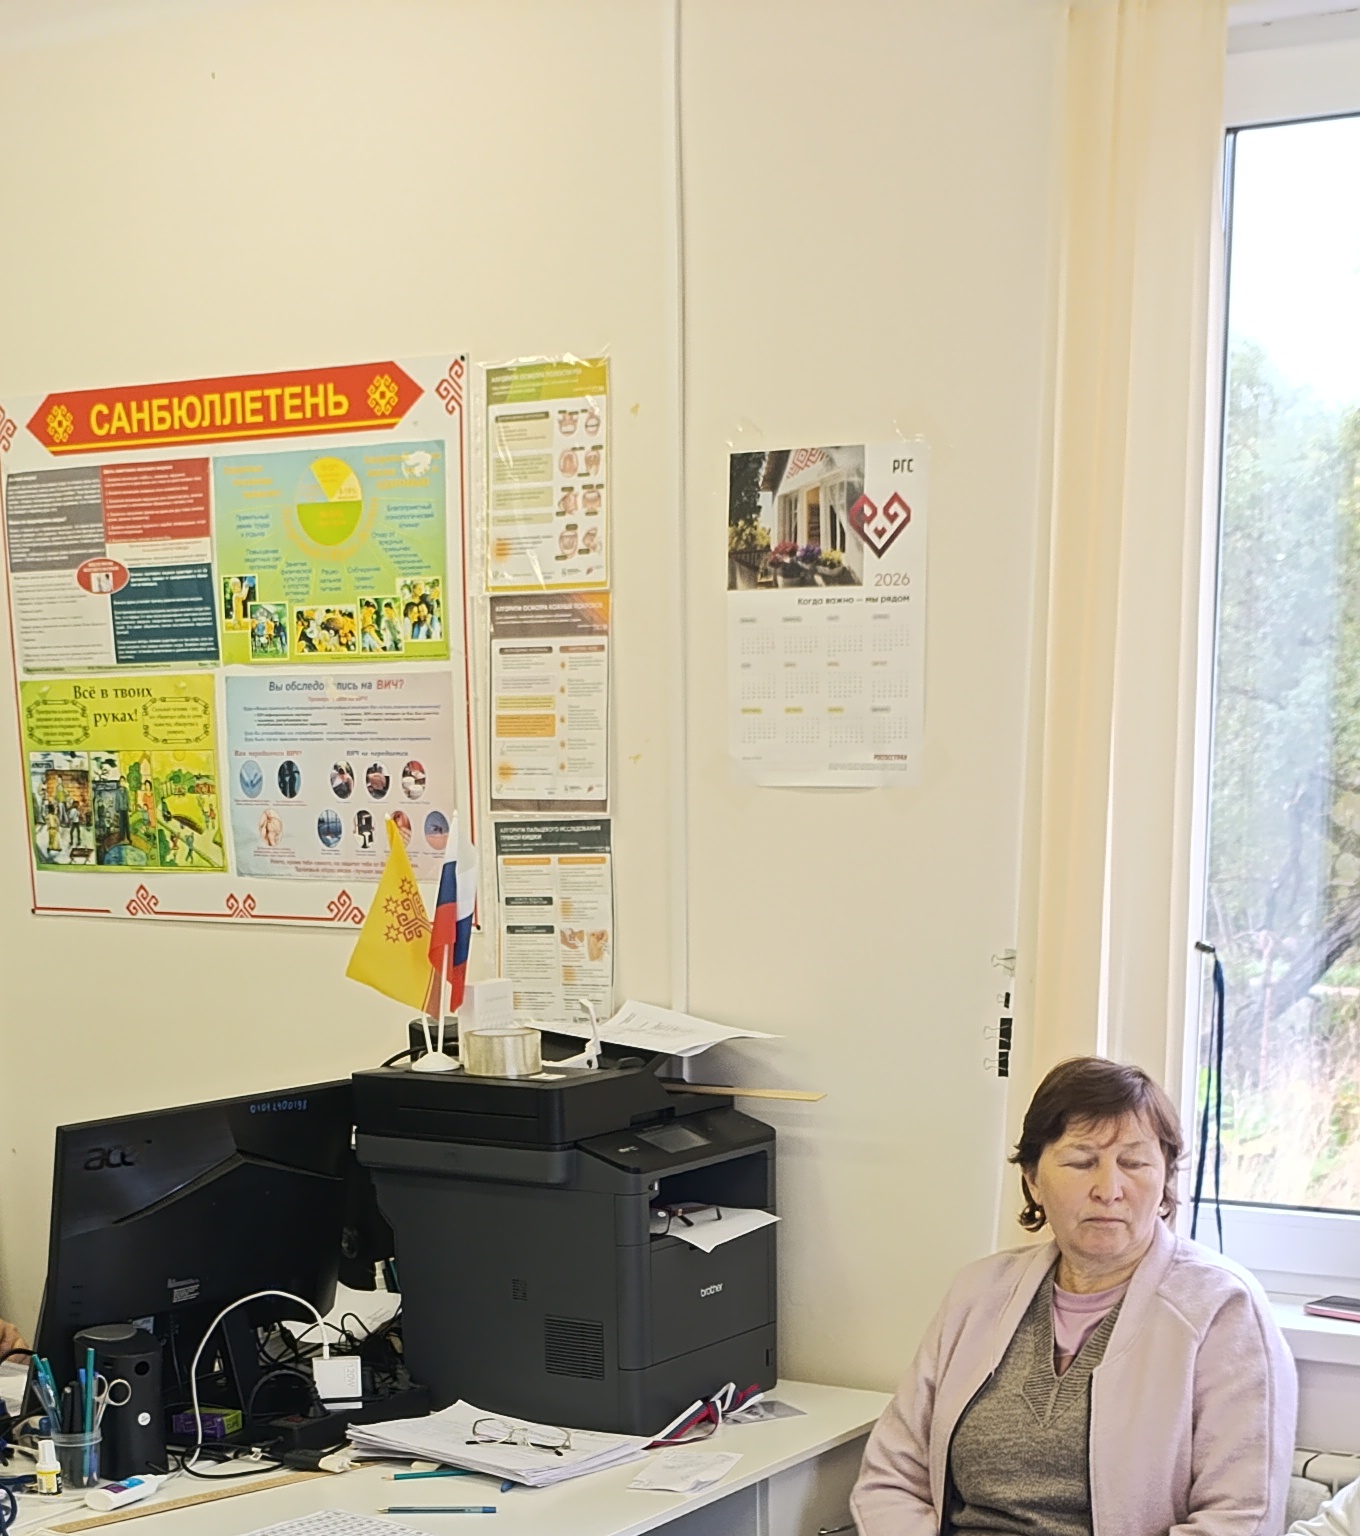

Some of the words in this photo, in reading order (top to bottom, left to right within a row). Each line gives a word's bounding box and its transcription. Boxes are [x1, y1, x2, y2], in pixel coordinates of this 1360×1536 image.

[89, 382, 350, 436] САНБЮЛЛЕТЕНЬ
[893, 460, 914, 473] РГС
[874, 573, 910, 586] 2026
[798, 597, 824, 606] Когда
[880, 595, 910, 604] рядом
[73, 685, 96, 700] Всё
[101, 689, 108, 698] в
[114, 687, 152, 698] твоих
[268, 682, 282, 692] Вы
[286, 680, 358, 692] обследолись
[376, 680, 404, 690] ВИЧ?
[94, 708, 138, 727] руках!
[84, 1145, 142, 1170] ace
[701, 1282, 724, 1298] brother
